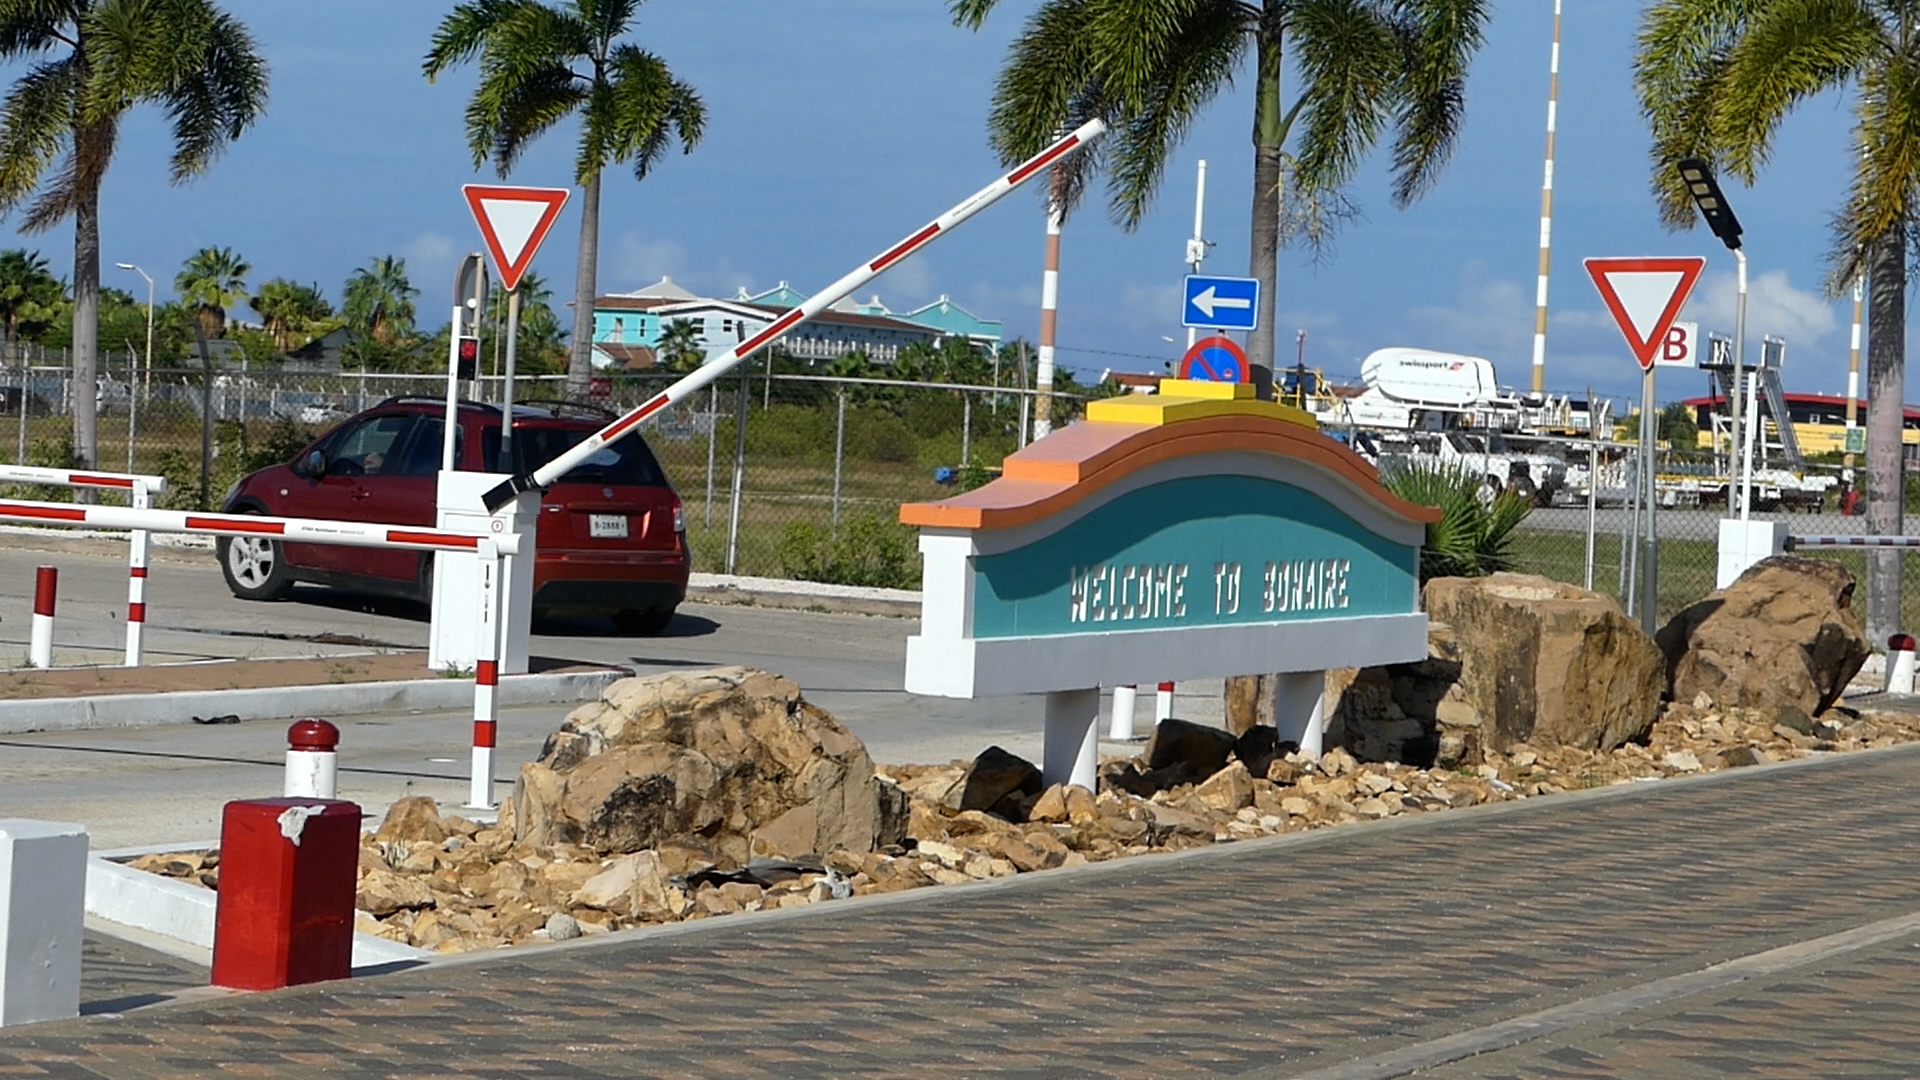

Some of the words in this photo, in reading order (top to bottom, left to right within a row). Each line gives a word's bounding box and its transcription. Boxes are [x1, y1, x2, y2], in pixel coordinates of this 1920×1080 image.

[1663, 326, 1688, 361] B
[1399, 359, 1449, 370] swissport
[1070, 563, 1189, 623] WELCOME
[1214, 561, 1242, 615] TO
[1263, 558, 1351, 613] BONAIRE
